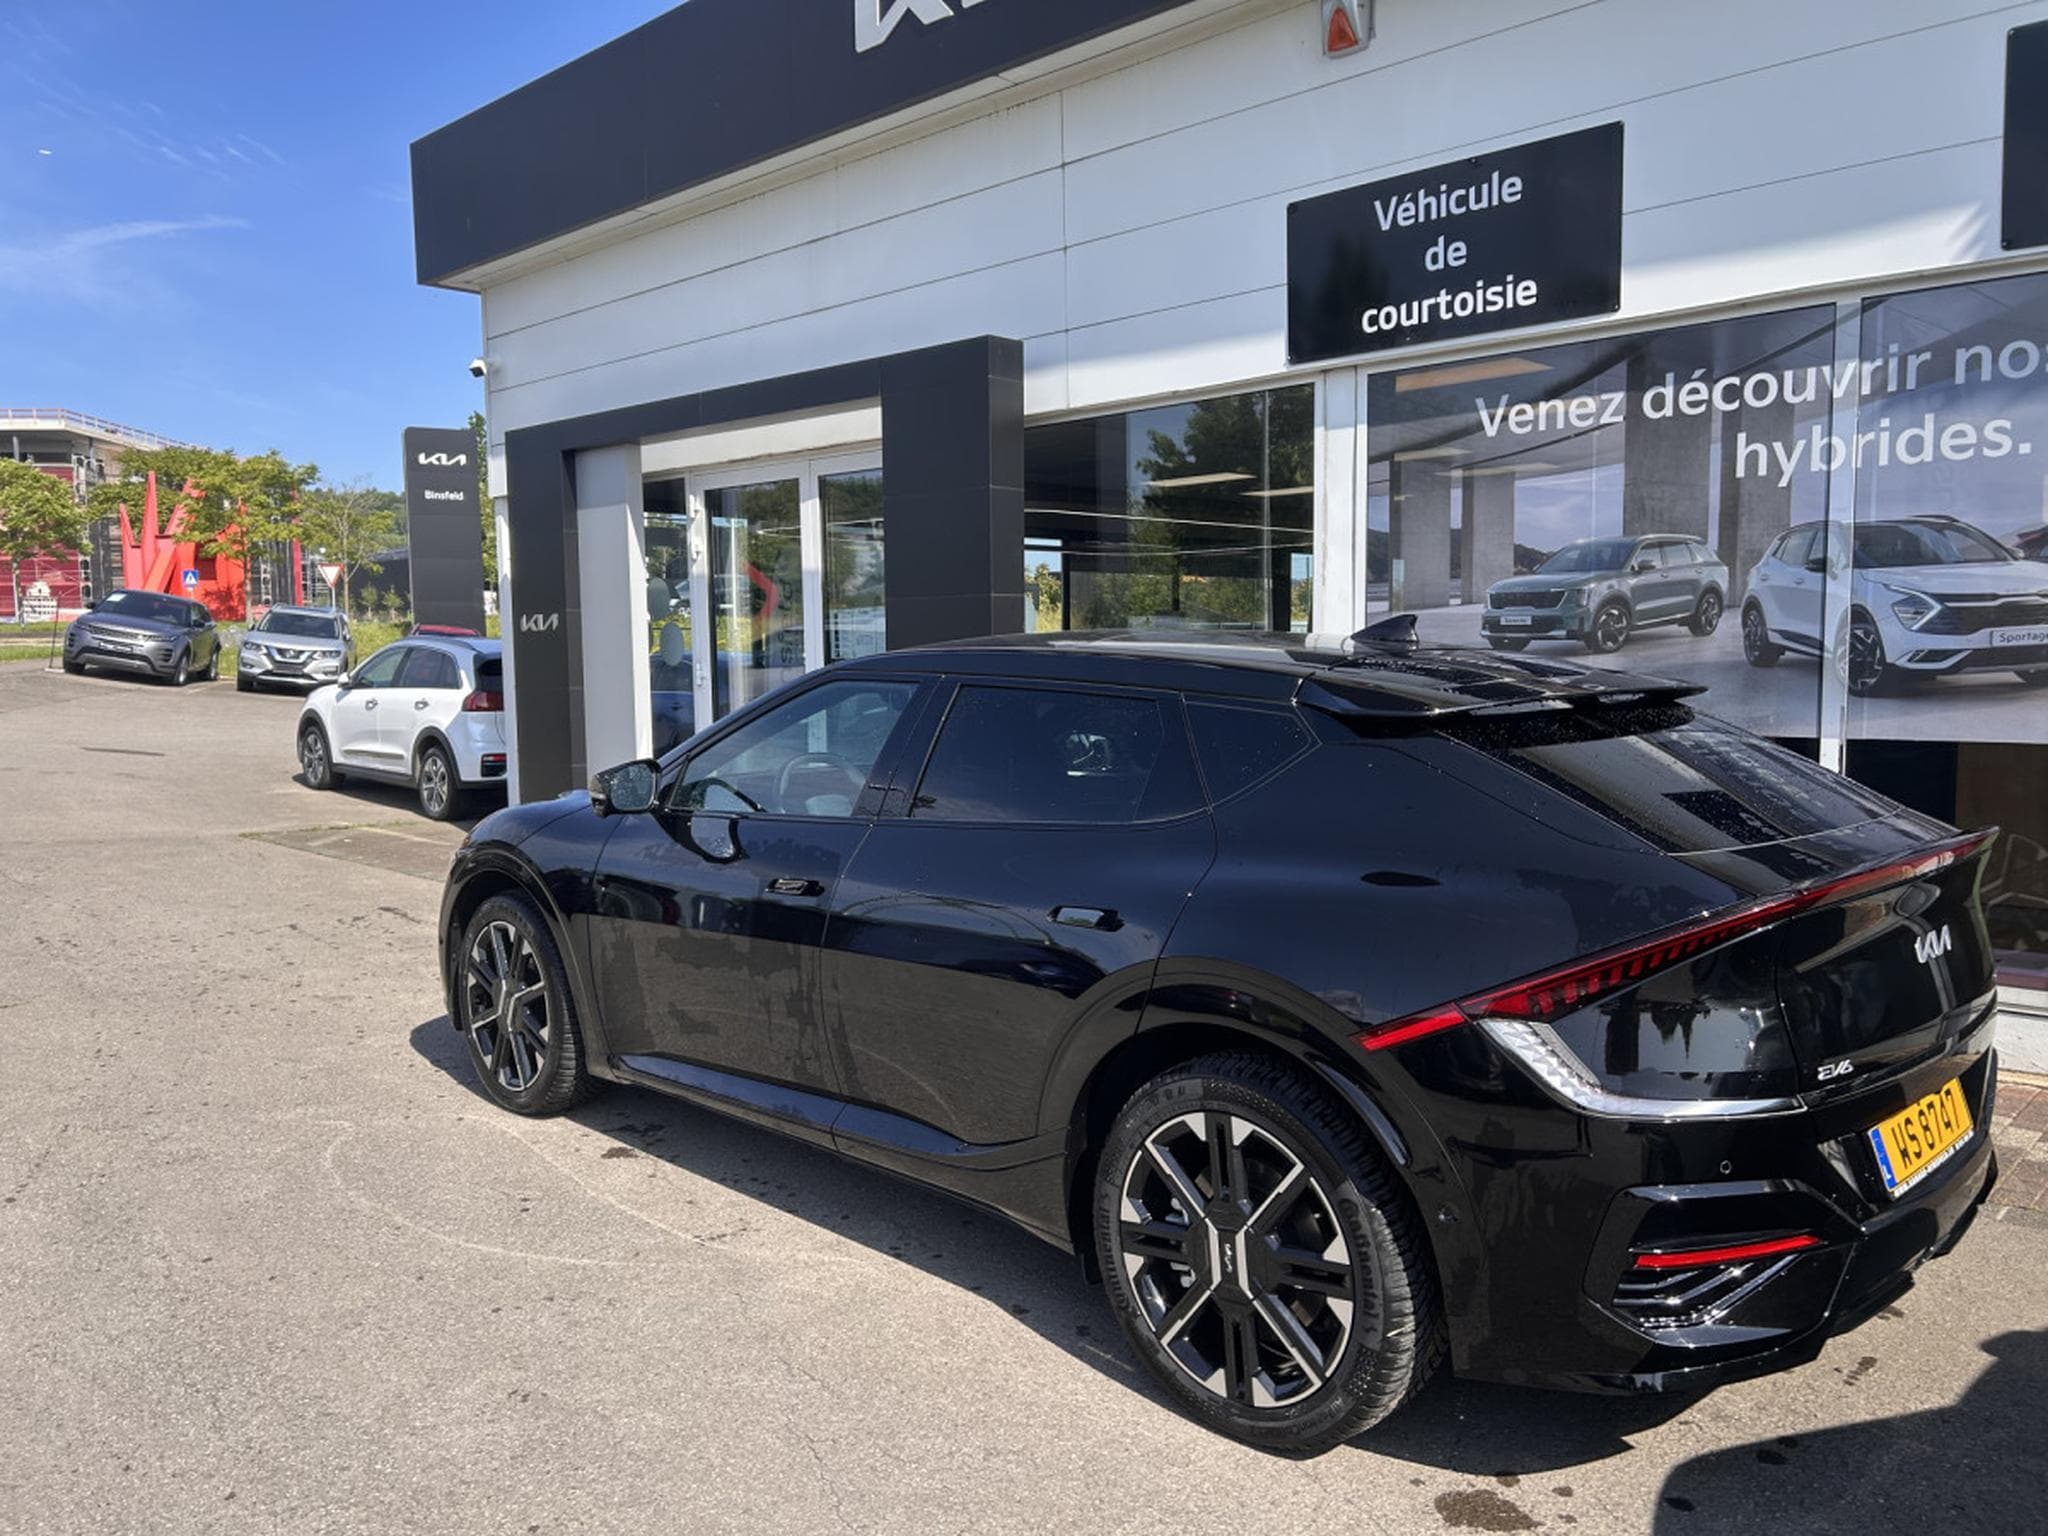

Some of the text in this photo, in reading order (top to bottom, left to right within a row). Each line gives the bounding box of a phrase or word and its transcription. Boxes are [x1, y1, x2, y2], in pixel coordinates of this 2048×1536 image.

[1373, 170, 1523, 231] Véhicule
[1424, 234, 1467, 272] de
[1361, 274, 1537, 333] courtoisie
[1475, 339, 2048, 438] Venez découvrir no
[418, 452, 467, 466] KIA
[1735, 412, 2032, 487] hybrides.
[424, 489, 464, 501] Binsfeld
[520, 613, 559, 632] KIA
[1817, 1059, 1854, 1081] EV6
